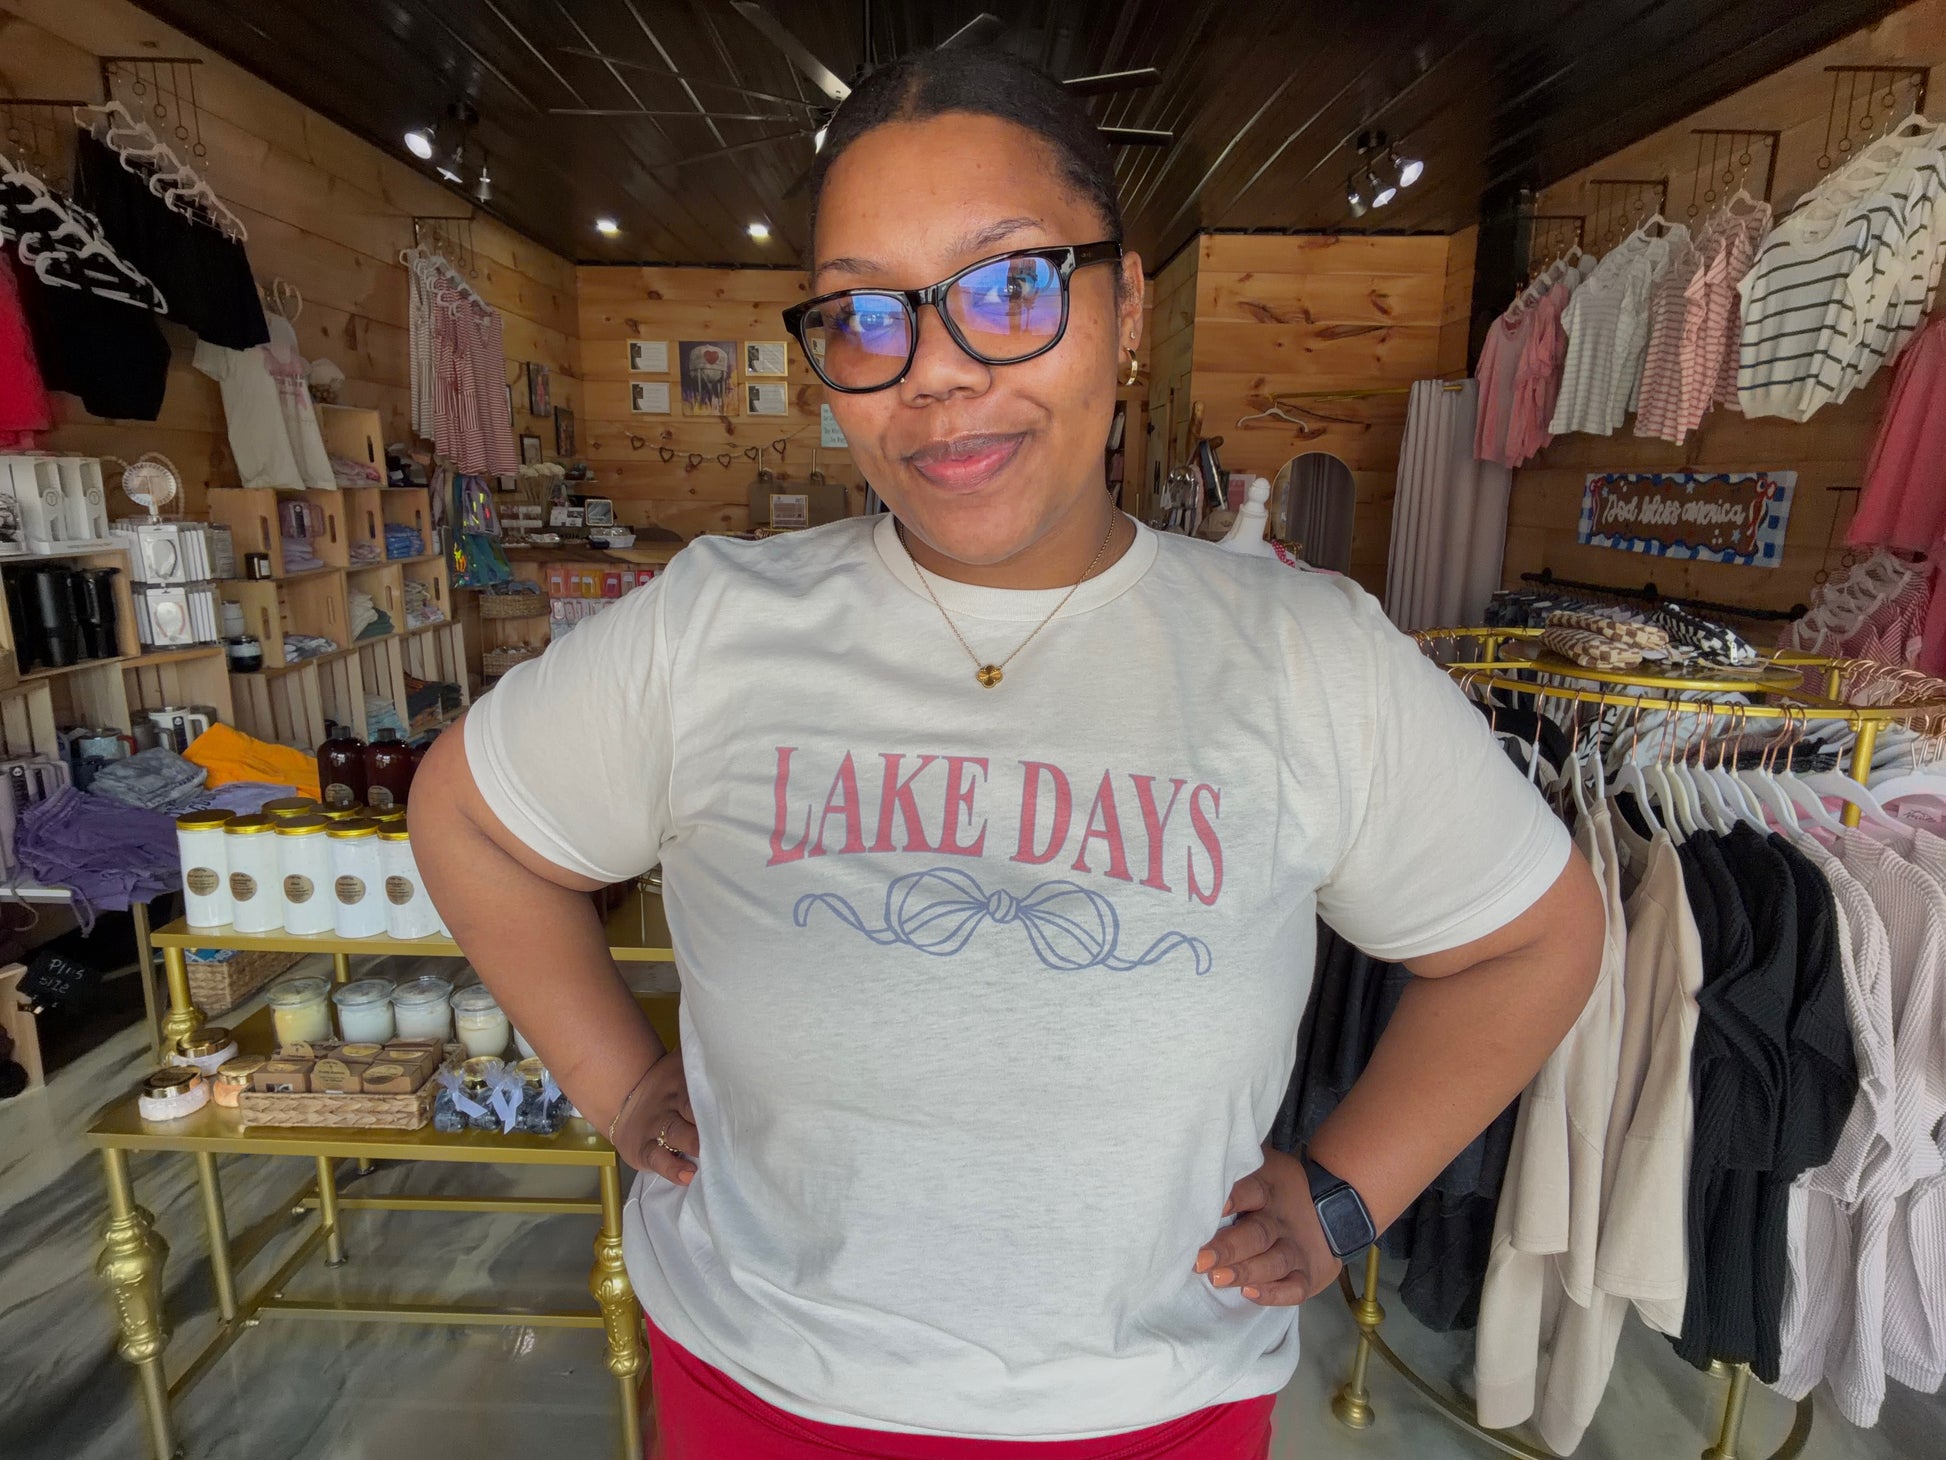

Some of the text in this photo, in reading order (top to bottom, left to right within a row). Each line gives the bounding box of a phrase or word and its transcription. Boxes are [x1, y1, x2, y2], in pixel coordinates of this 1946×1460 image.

[1637, 495, 1682, 525] bless
[766, 747, 1224, 906] LAKE DAYS
